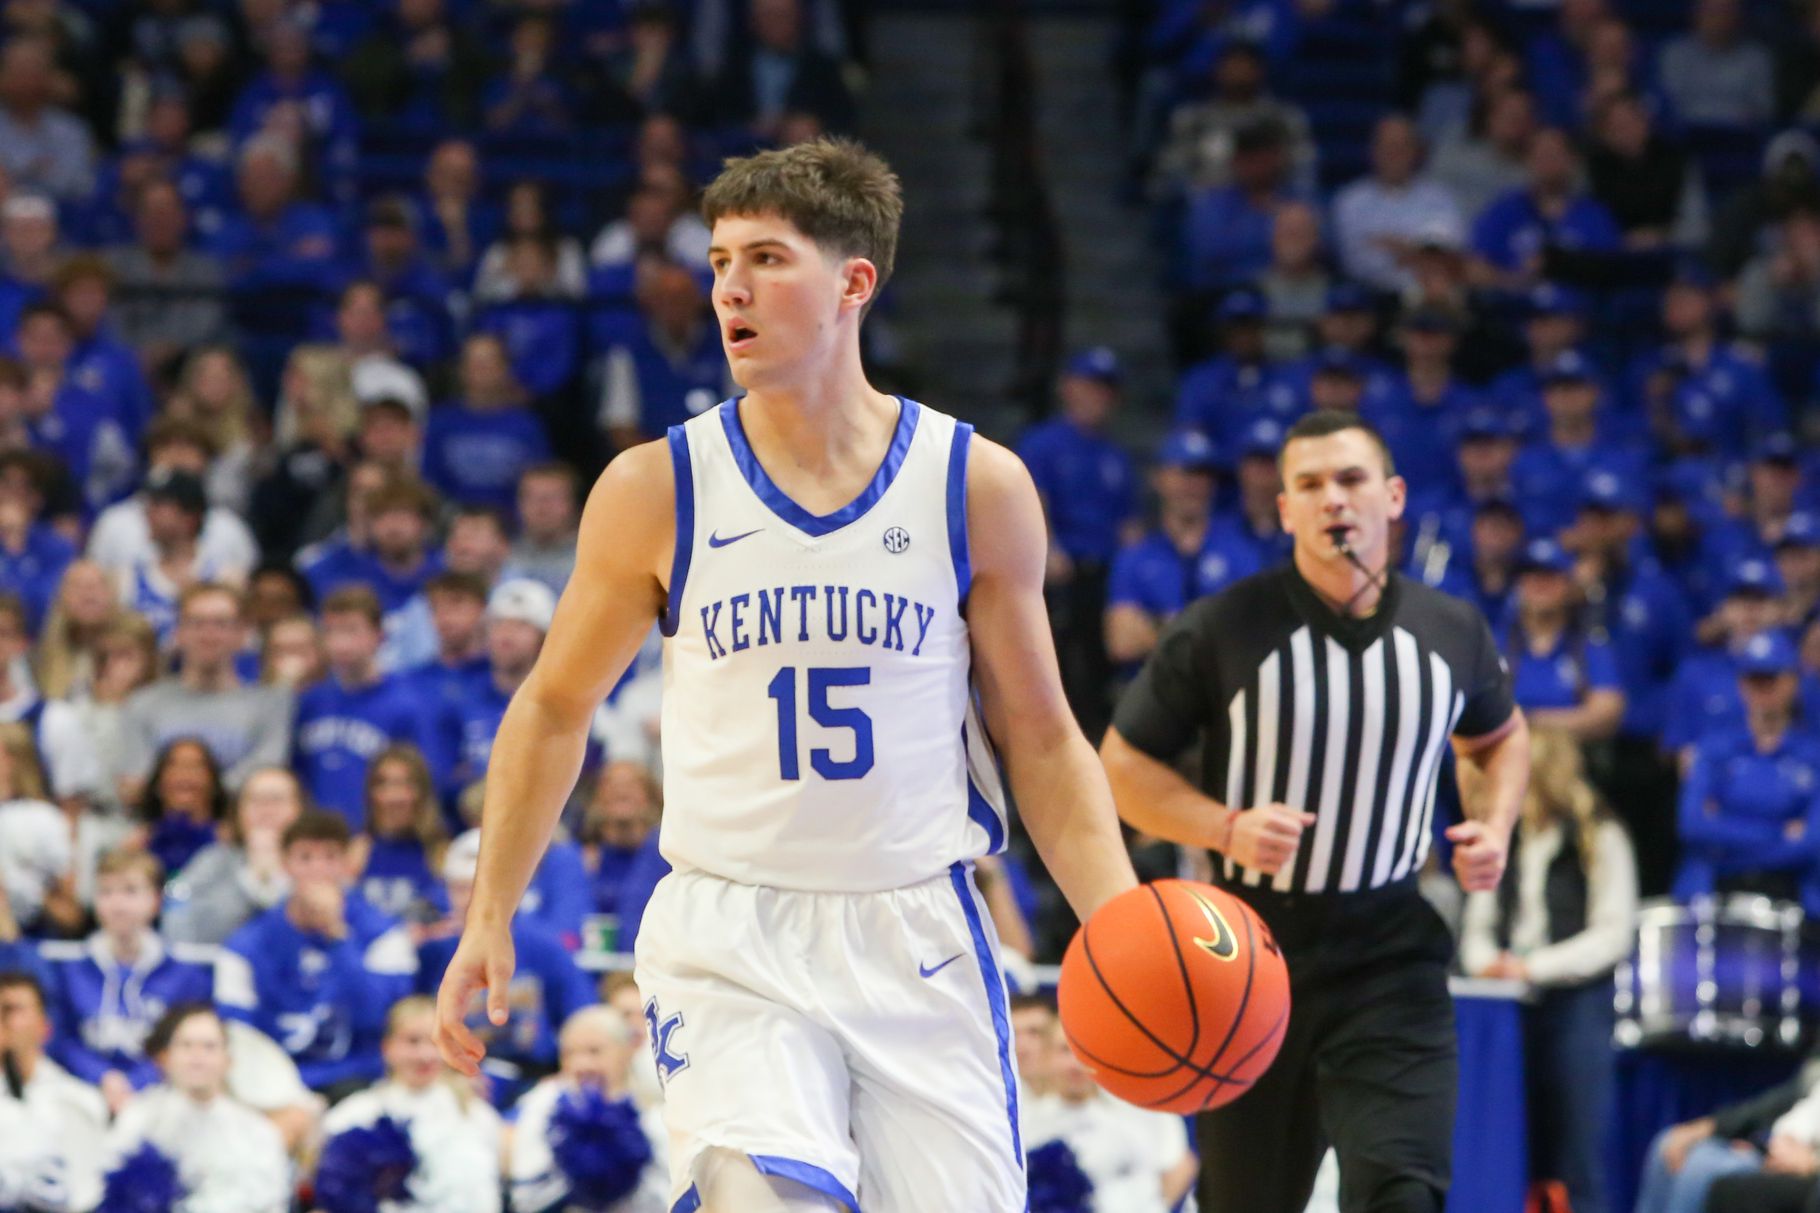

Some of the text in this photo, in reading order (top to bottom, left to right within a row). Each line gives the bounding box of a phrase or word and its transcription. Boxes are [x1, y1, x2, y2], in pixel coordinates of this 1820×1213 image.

[884, 527, 910, 553] SEC
[700, 585, 935, 660] KENTUCKY
[768, 666, 875, 781] 15
